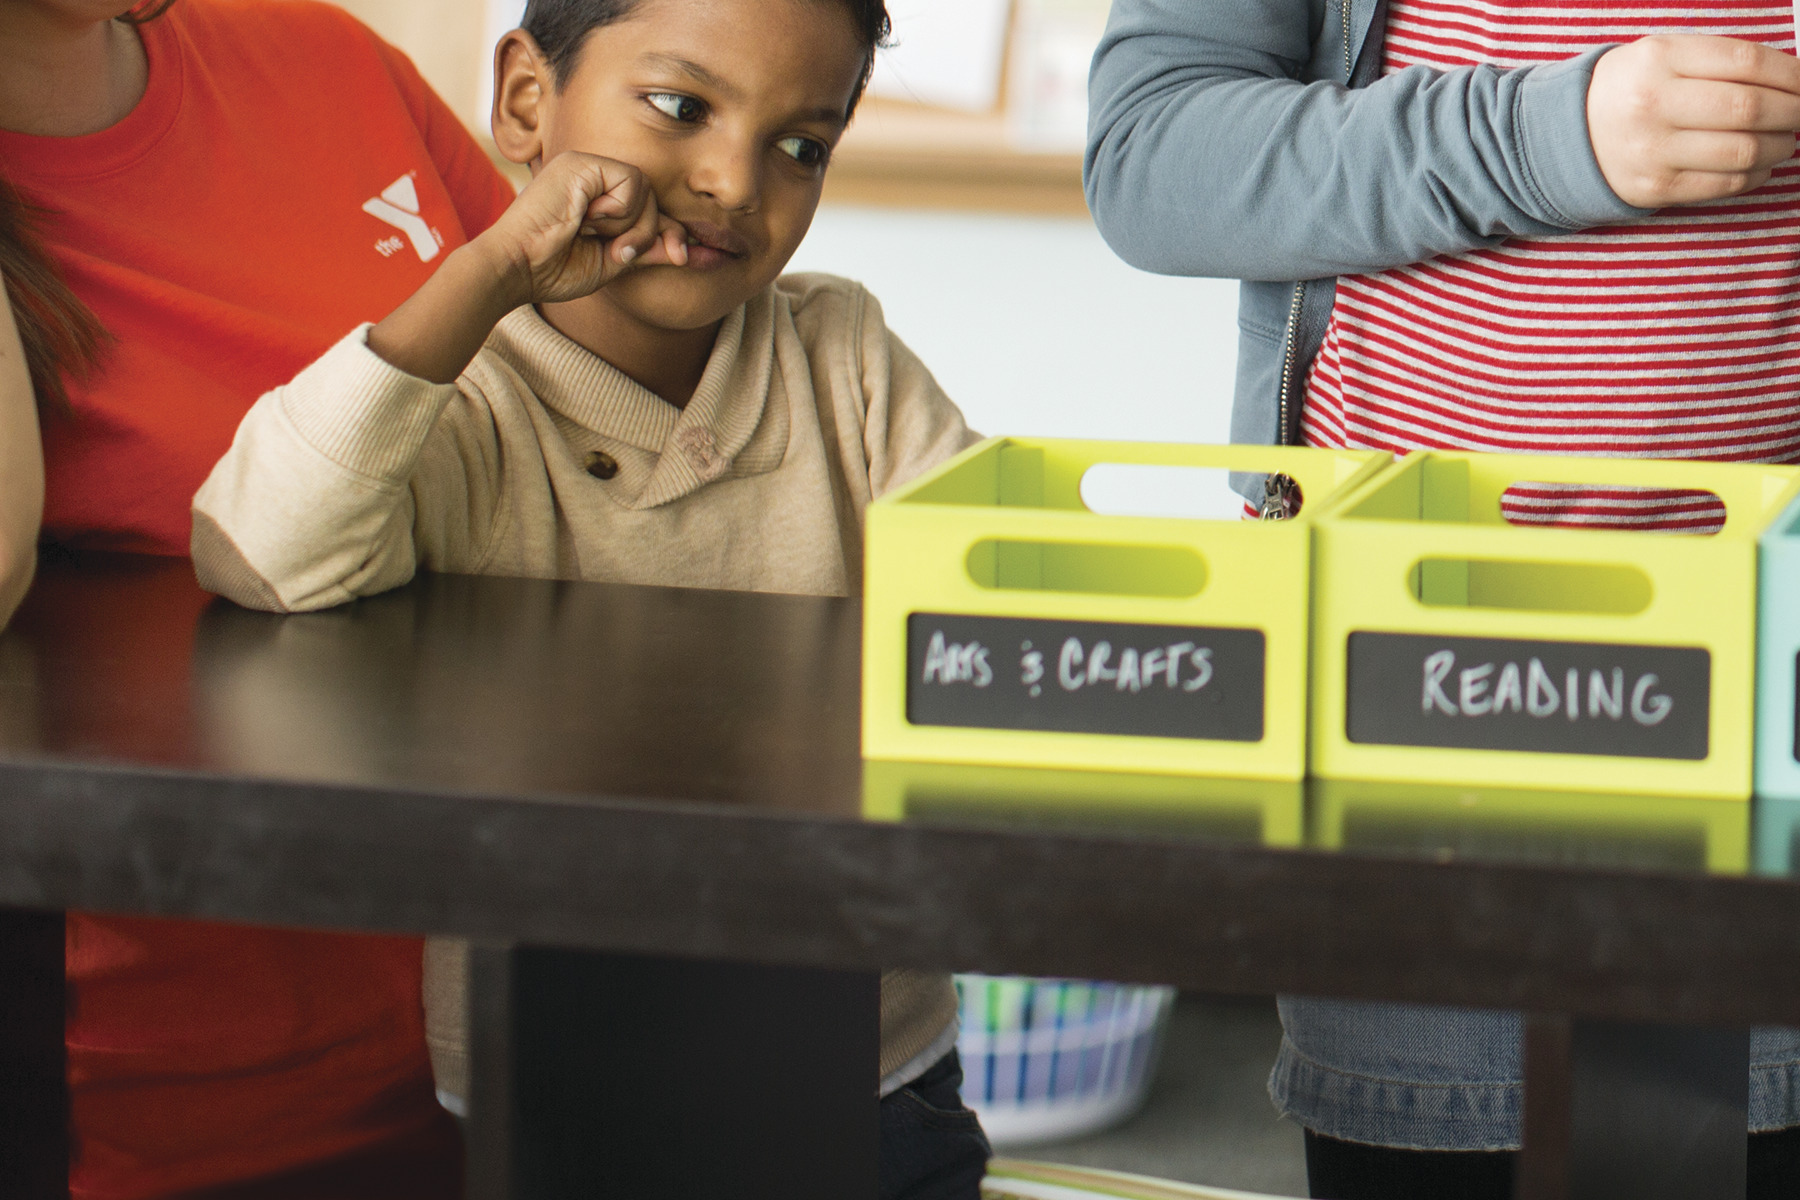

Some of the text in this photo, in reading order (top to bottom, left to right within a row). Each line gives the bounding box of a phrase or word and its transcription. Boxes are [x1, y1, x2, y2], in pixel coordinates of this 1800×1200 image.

[362, 174, 440, 263] the Y
[1058, 636, 1214, 692] CRAFTS
[1421, 649, 1674, 726] READING
